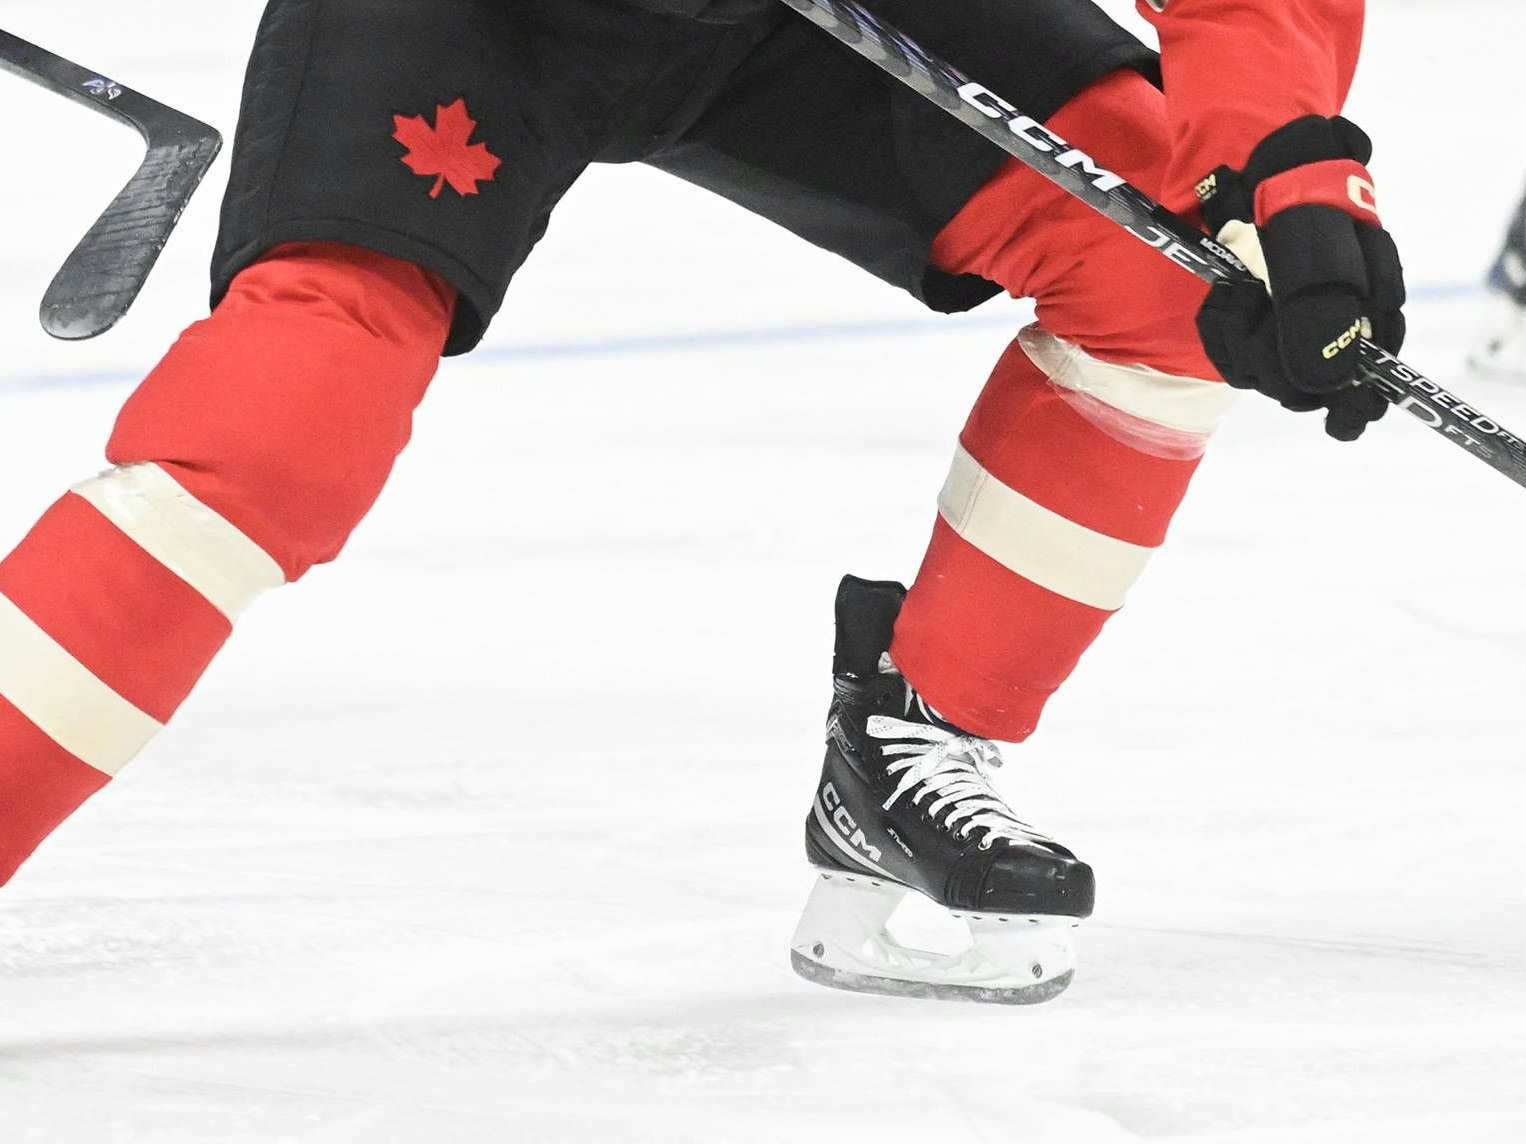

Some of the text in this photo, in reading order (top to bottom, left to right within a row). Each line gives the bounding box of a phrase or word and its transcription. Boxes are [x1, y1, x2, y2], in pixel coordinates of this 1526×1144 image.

[957, 81, 1127, 194] CCM
[1123, 224, 1230, 280] JE
[1321, 317, 1361, 359] CCM
[822, 781, 882, 863] CCM
